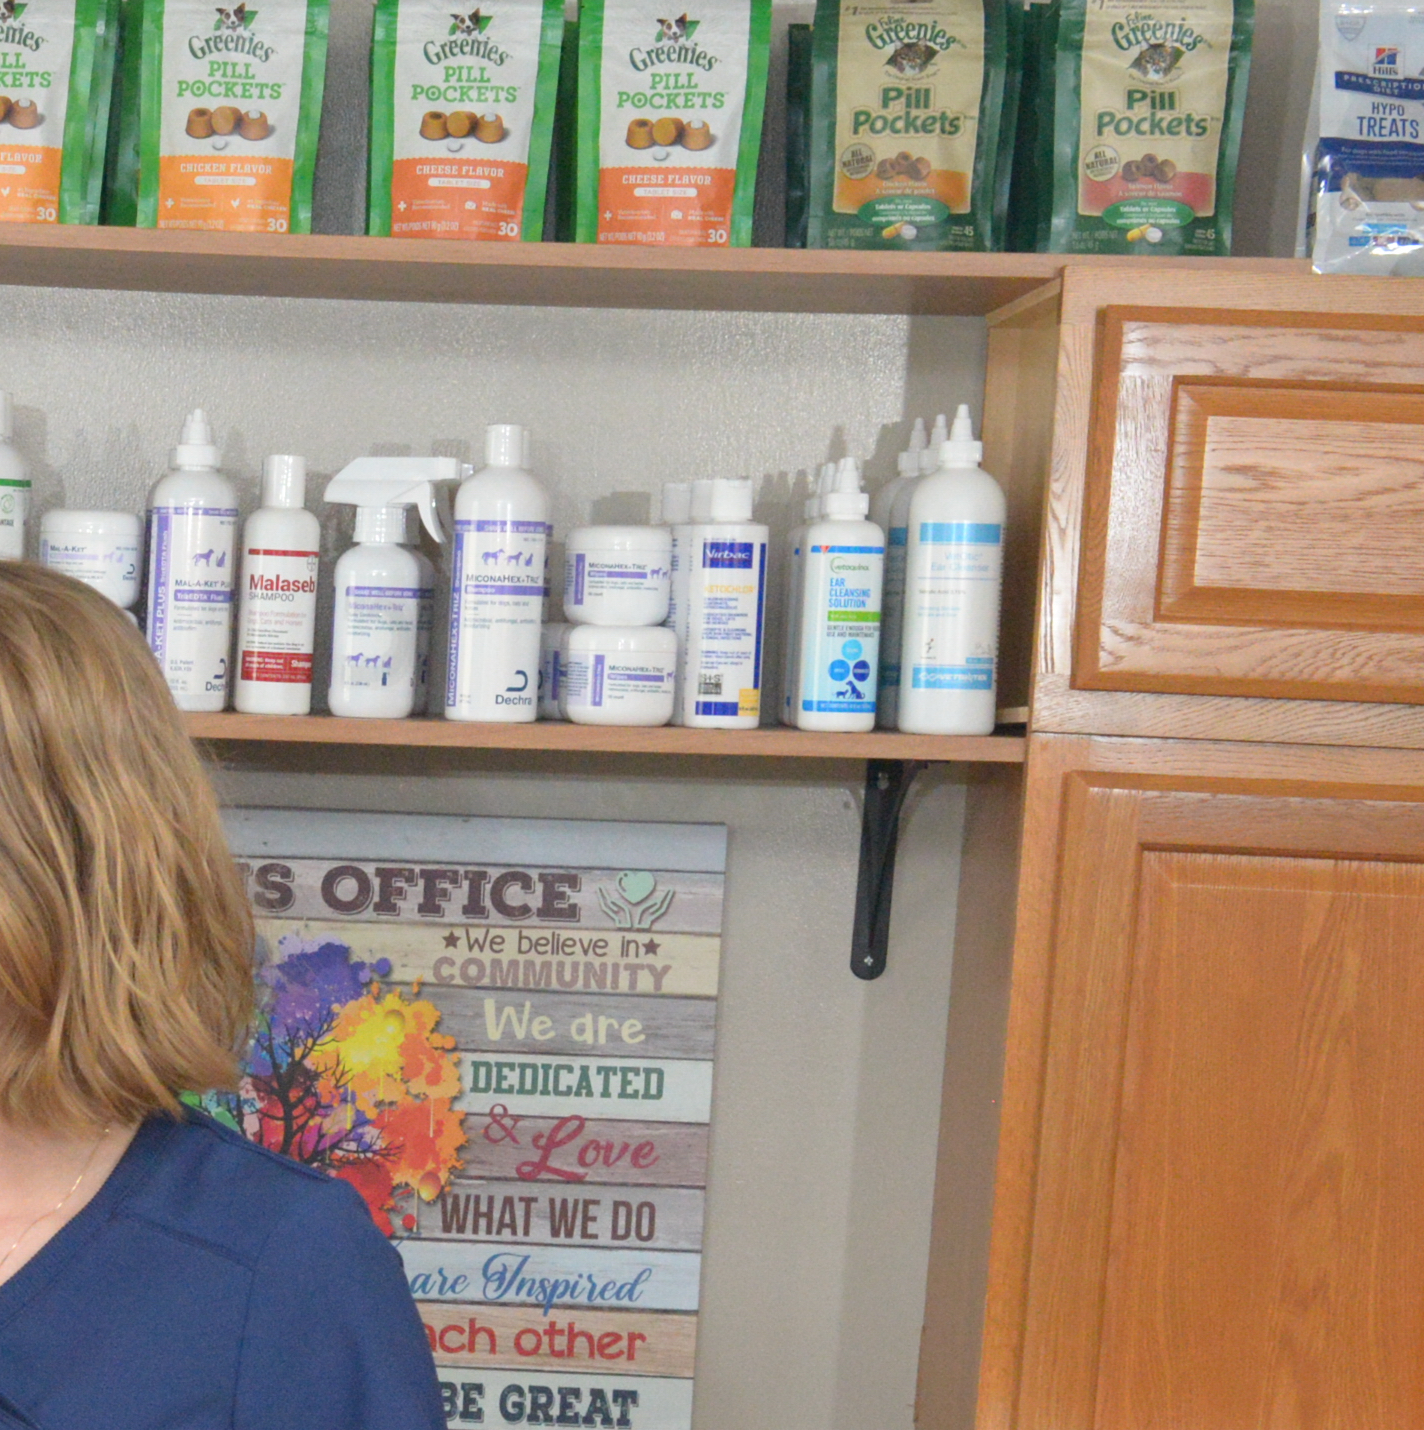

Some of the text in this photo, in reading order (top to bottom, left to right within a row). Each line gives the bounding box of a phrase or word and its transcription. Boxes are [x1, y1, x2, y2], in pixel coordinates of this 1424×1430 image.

[864, 19, 958, 52] Greenies
[1110, 16, 1204, 52] Greenies
[187, 33, 275, 63] Greenies
[422, 36, 510, 67] Greenies
[628, 43, 720, 73] Greenies
[207, 60, 256, 80] PILL
[442, 65, 491, 84] PILL
[1372, 64, 1400, 77] Hill's
[176, 79, 282, 100] POCKETS
[649, 71, 699, 91] PILL
[1343, 73, 1424, 91] PRESCRIPTIO
[1373, 85, 1401, 96] DIET
[410, 83, 519, 104] POCKETS
[616, 90, 726, 111] POCKETS
[881, 86, 931, 110] Pill
[1126, 88, 1176, 111] Pill
[1371, 101, 1406, 117] HYPO
[852, 110, 962, 136] Pockets
[1096, 110, 1209, 137] Pockets
[1356, 115, 1421, 140] TREATS
[0, 152, 43, 164] FLAVOR
[180, 163, 273, 175] CHICKEN FLAVOR
[415, 165, 505, 178] CHEESE FLAVOR
[621, 173, 712, 185] CHEESE FLAVOR
[35, 206, 57, 222] 30
[266, 218, 288, 233] 30
[497, 221, 519, 237] 30
[707, 229, 728, 244] 30
[705, 549, 751, 560] Virbac
[249, 573, 316, 593] Malaseb
[829, 577, 846, 588] EAR
[156, 585, 166, 617] PLUS
[248, 591, 295, 602] SHAMPOO
[828, 598, 867, 609] SOLUTION
[829, 588, 872, 599] CLEANSING
[447, 592, 459, 706] MICONAHEX+TRIZ
[495, 694, 533, 706] Dechra
[320, 864, 583, 923] OFFICE
[464, 927, 640, 959] We believe in
[432, 955, 673, 994] COMMUNITY
[483, 997, 647, 1045] We are
[469, 1059, 665, 1102] DEDICATED
[483, 1103, 525, 1145] &
[515, 1114, 661, 1182] Love
[439, 1192, 657, 1243] WHAT WE DO
[409, 1252, 653, 1318] are Inspired
[513, 1320, 647, 1362] other
[498, 1382, 640, 1430] GREAT
